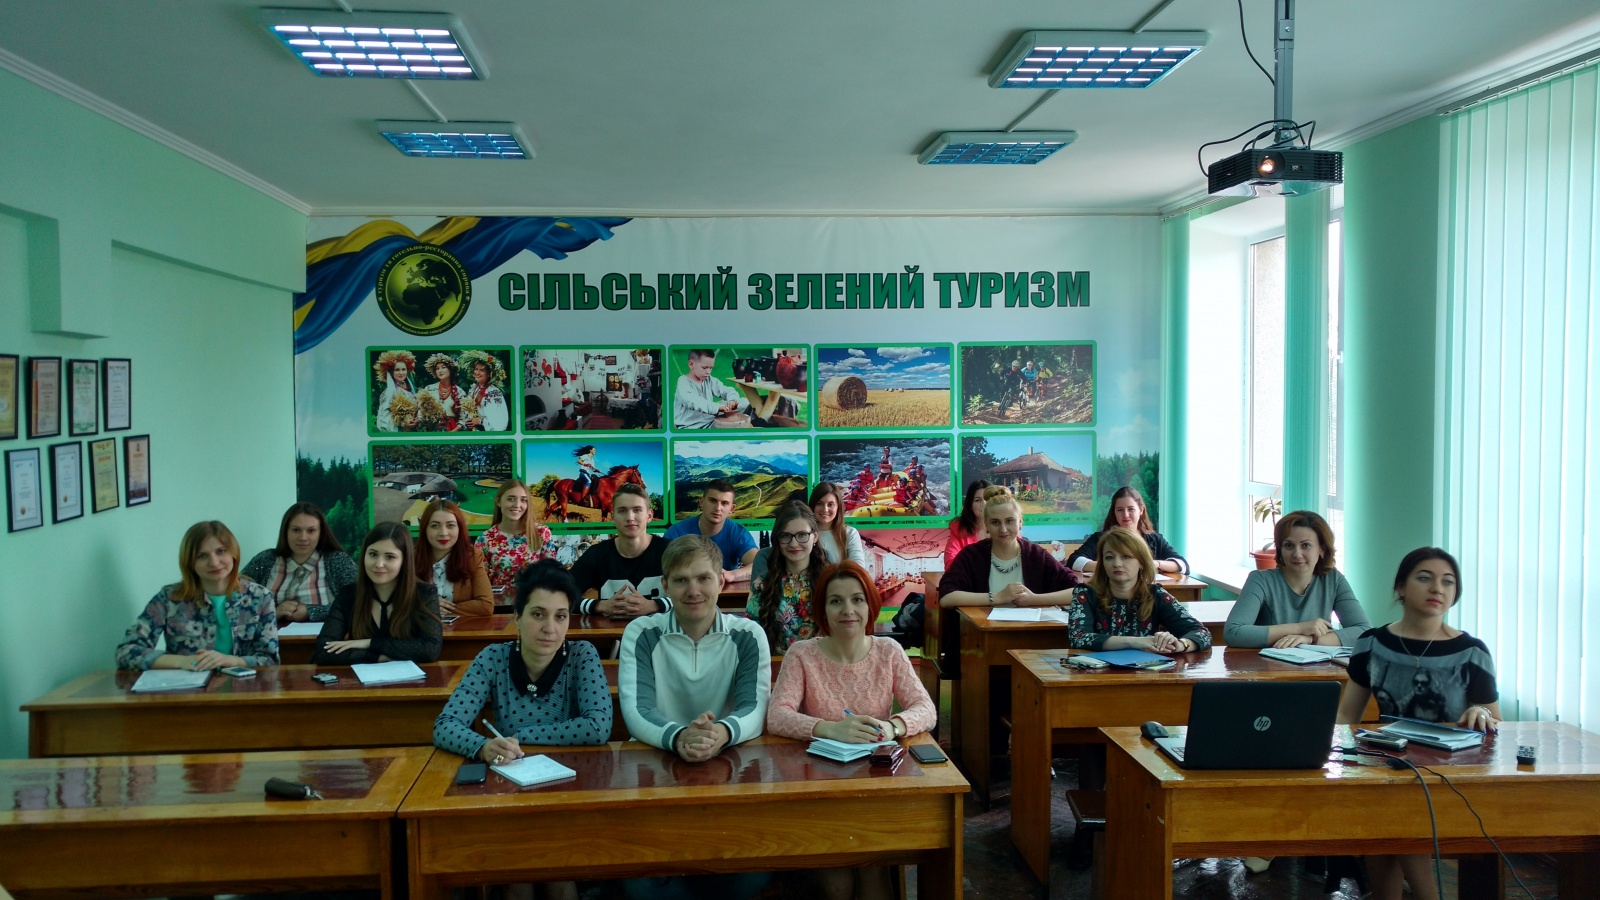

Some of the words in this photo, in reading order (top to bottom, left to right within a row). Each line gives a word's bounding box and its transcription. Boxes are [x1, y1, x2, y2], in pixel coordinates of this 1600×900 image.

[498, 266, 738, 311] СІЛЬСЬКИЙ
[748, 265, 924, 311] ЗЕЛЕНИЙ
[933, 271, 1090, 309] ТУРИЗМ
[1255, 716, 1270, 731] hp
